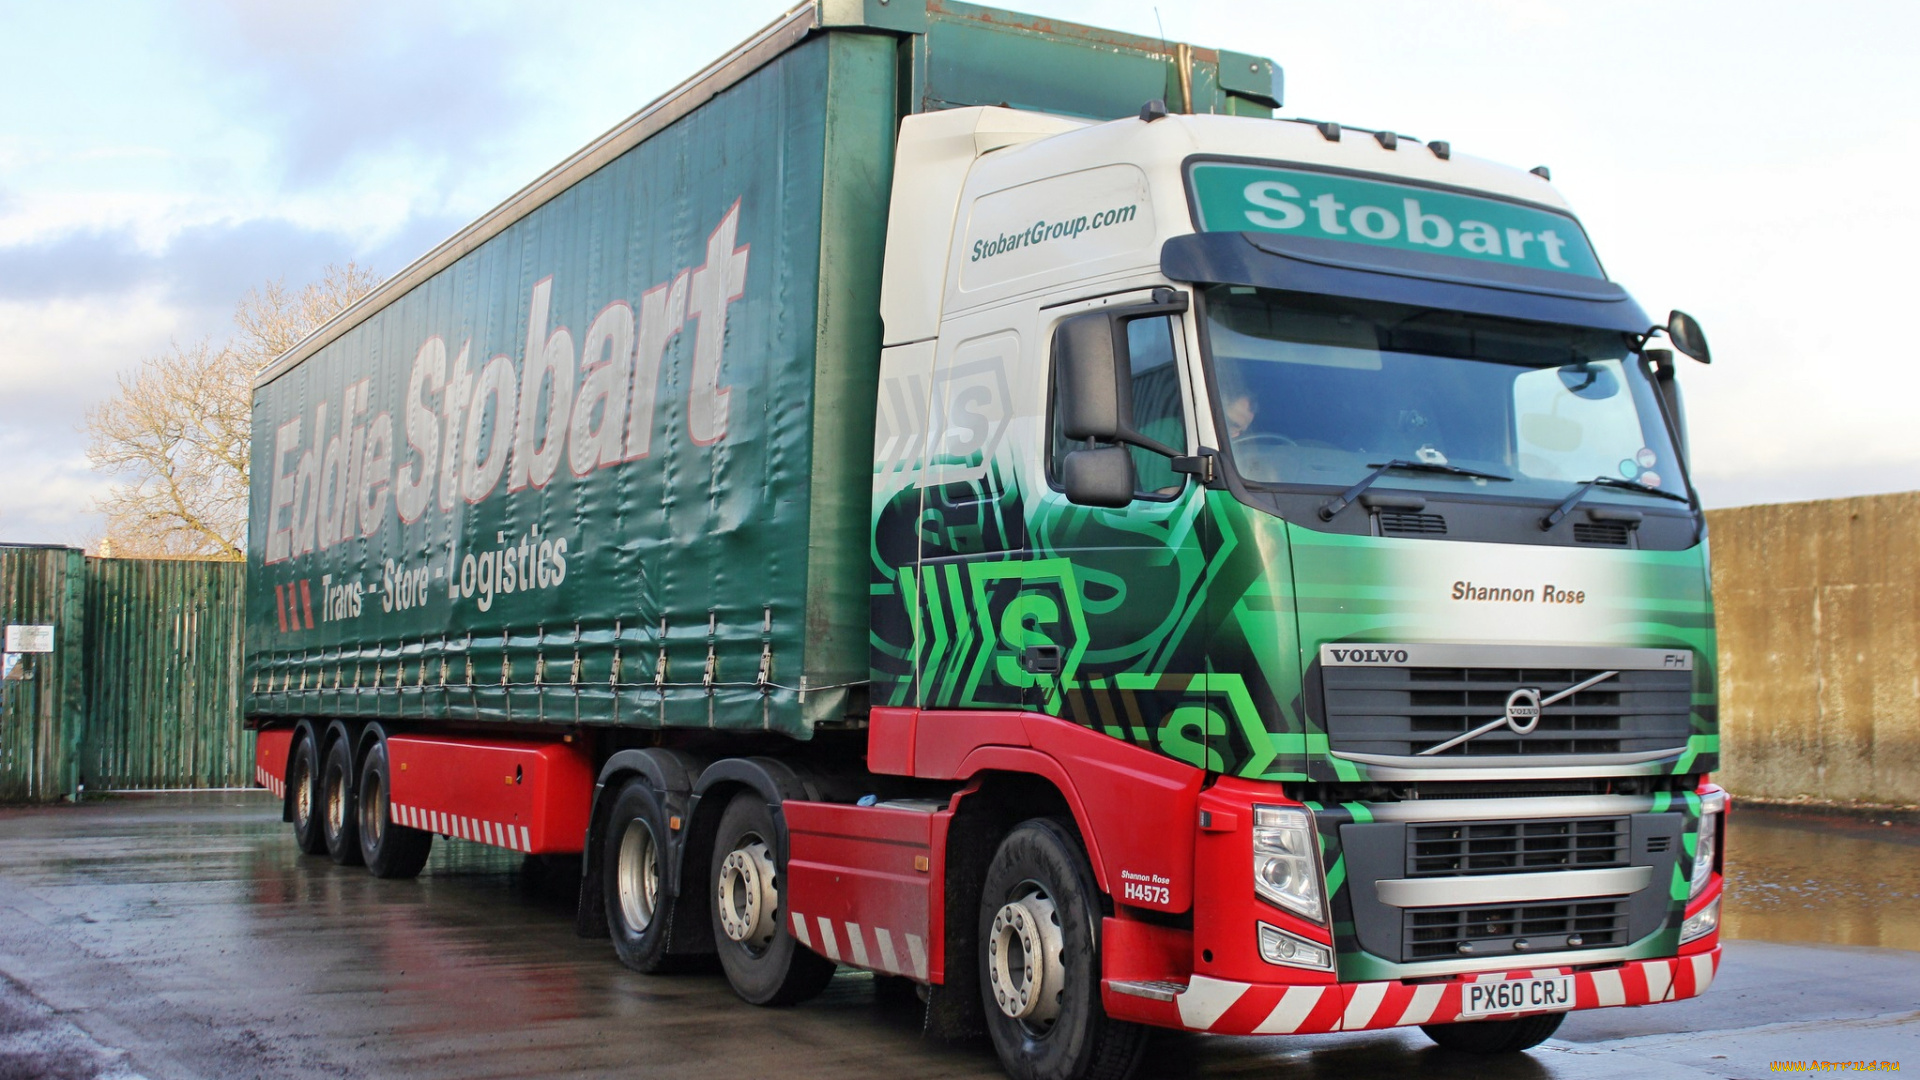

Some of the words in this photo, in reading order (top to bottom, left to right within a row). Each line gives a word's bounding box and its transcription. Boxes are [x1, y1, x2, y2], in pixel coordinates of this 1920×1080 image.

[971, 204, 1137, 262] StobartGroup.com
[1243, 180, 1570, 268] Stobart
[265, 376, 393, 566] Eddie
[396, 195, 751, 525] Stobart
[322, 574, 362, 622] Trans
[382, 557, 429, 613] Store
[449, 523, 567, 612] Logistics
[1451, 580, 1535, 602] Shannon
[1542, 584, 1586, 604] Rose
[1330, 649, 1408, 663] VOLVO
[1664, 654, 1686, 667] FH
[1121, 869, 1151, 882] Shannon
[1151, 874, 1170, 885] Rose
[1124, 882, 1170, 905] H4573
[1471, 982, 1524, 1011] PX60
[1531, 979, 1568, 1005] CRJ
